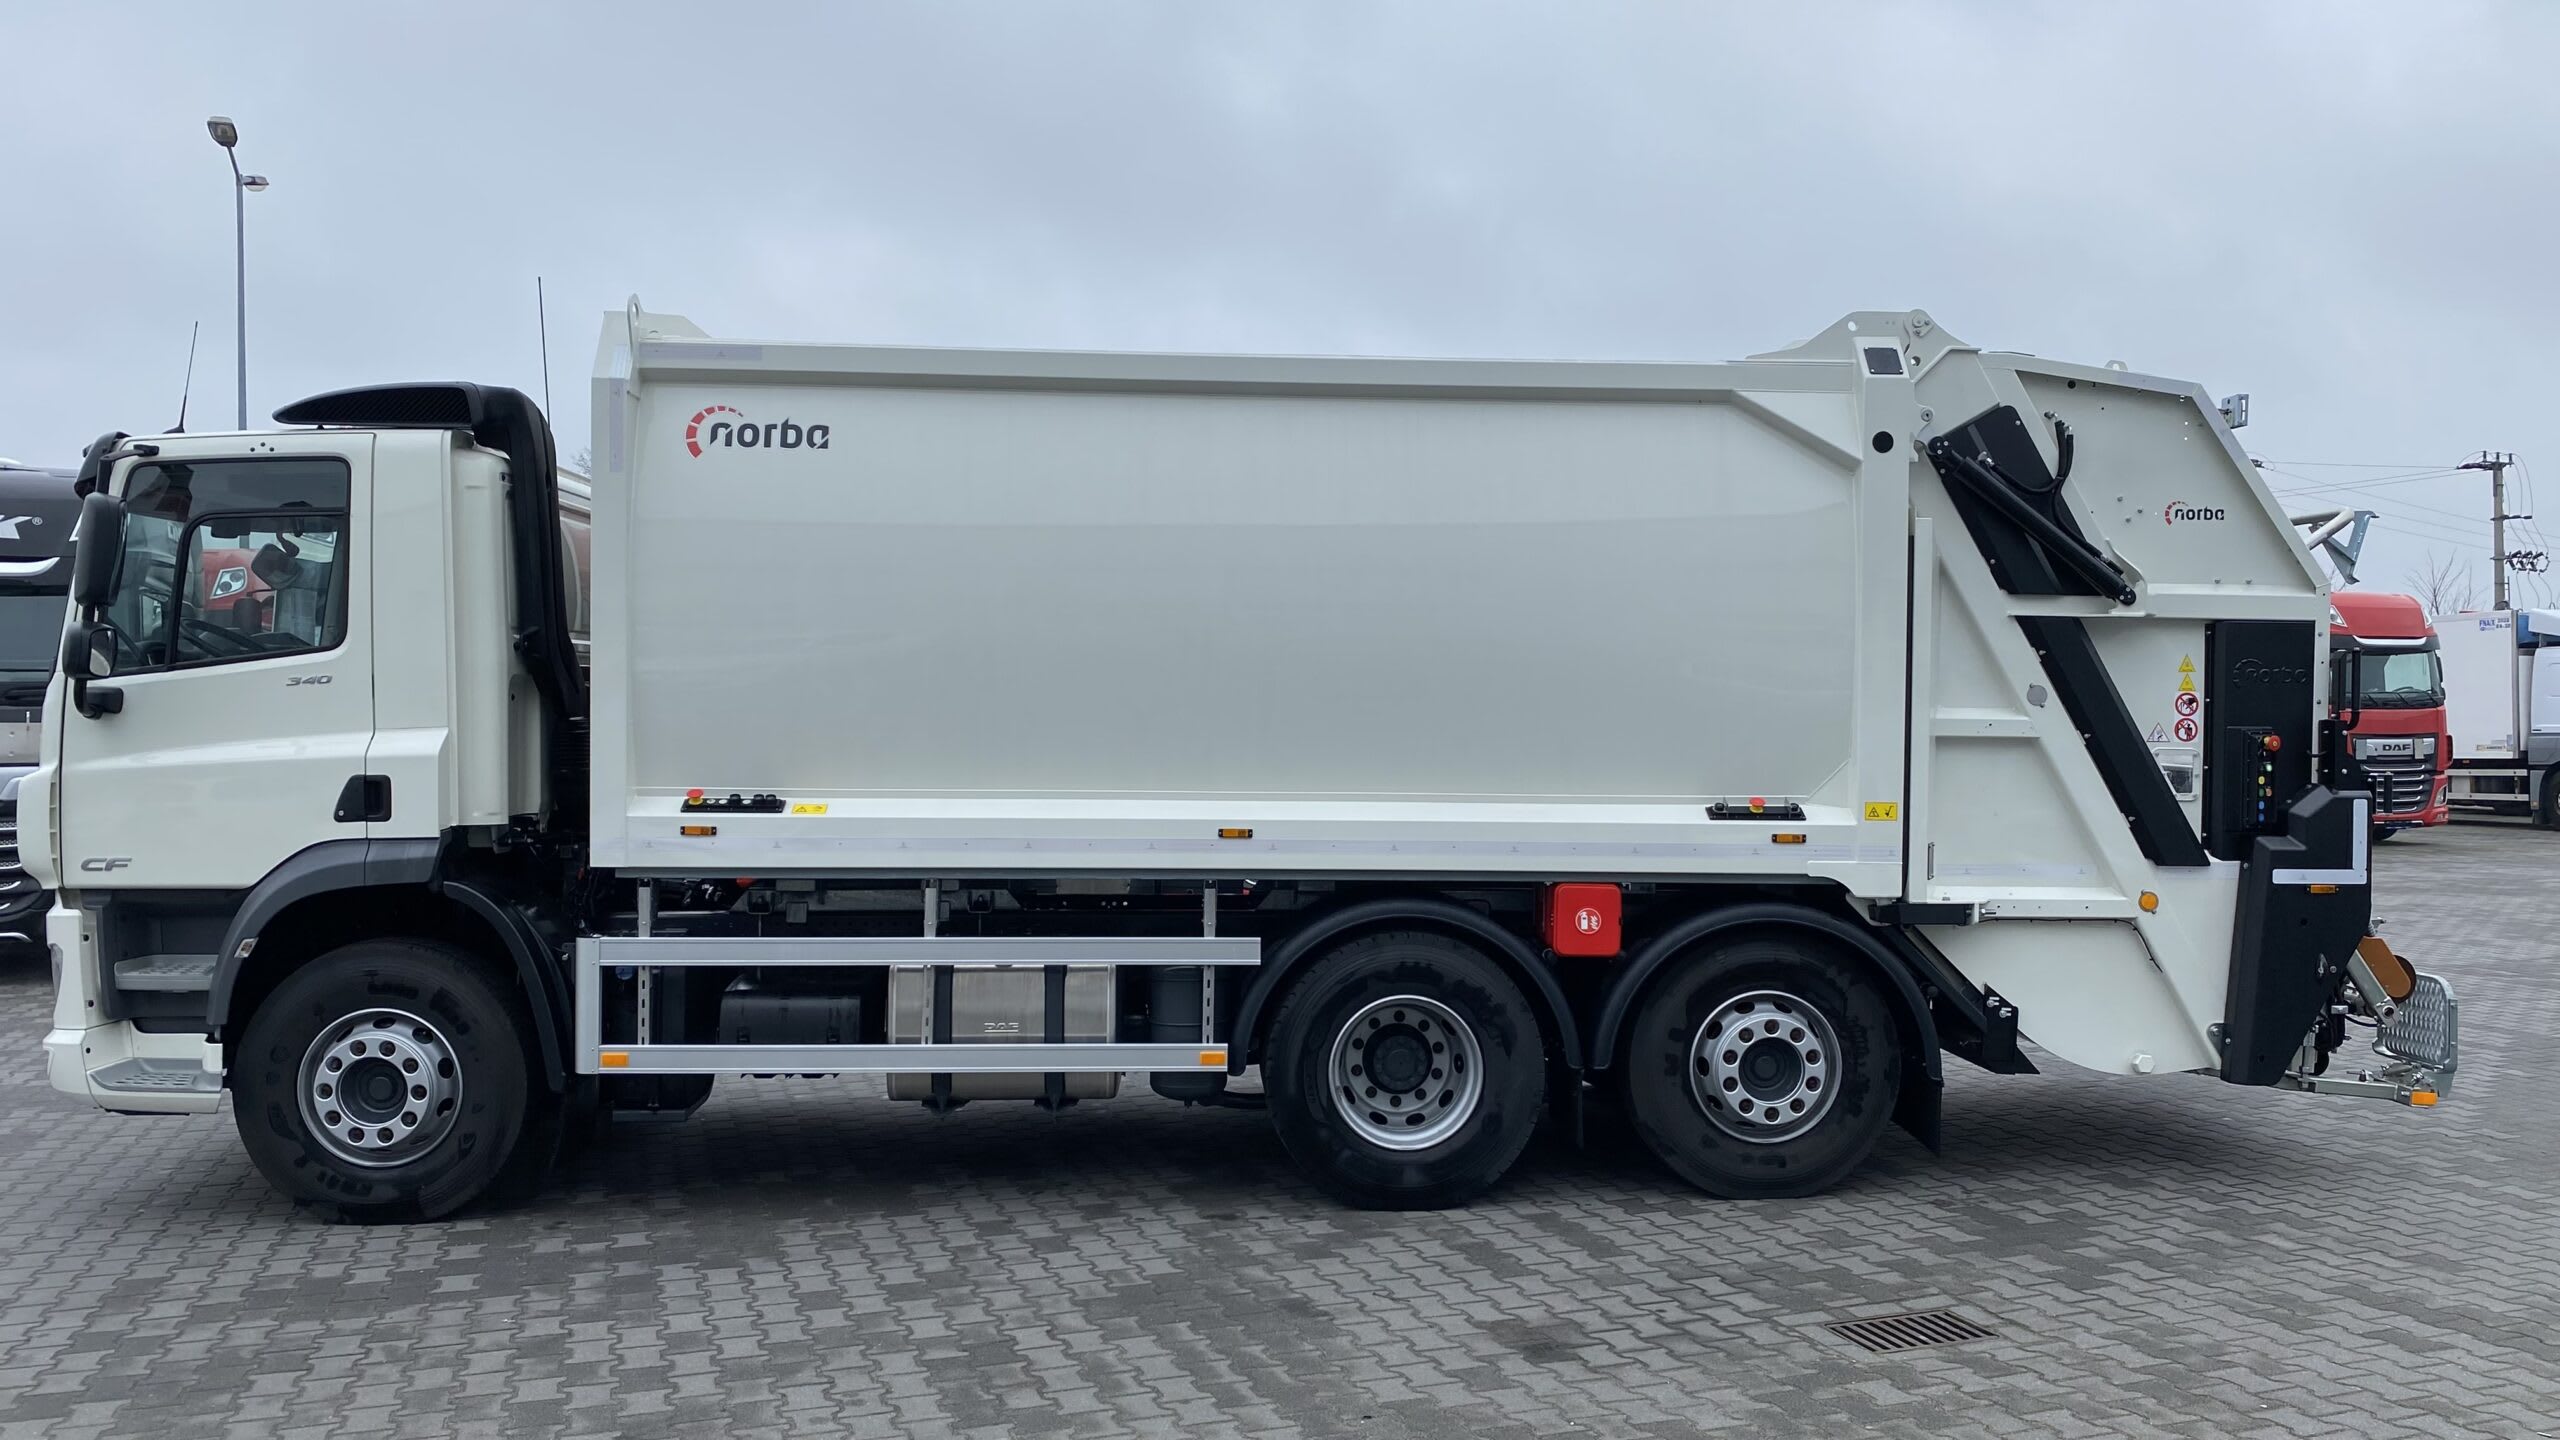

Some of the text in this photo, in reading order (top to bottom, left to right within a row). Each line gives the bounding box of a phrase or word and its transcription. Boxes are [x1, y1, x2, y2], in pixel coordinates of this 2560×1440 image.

[709, 417, 830, 449] norba
[2174, 506, 2225, 521] norba
[285, 674, 333, 687] 340
[2382, 744, 2412, 752] DAF
[80, 857, 133, 872] CF
